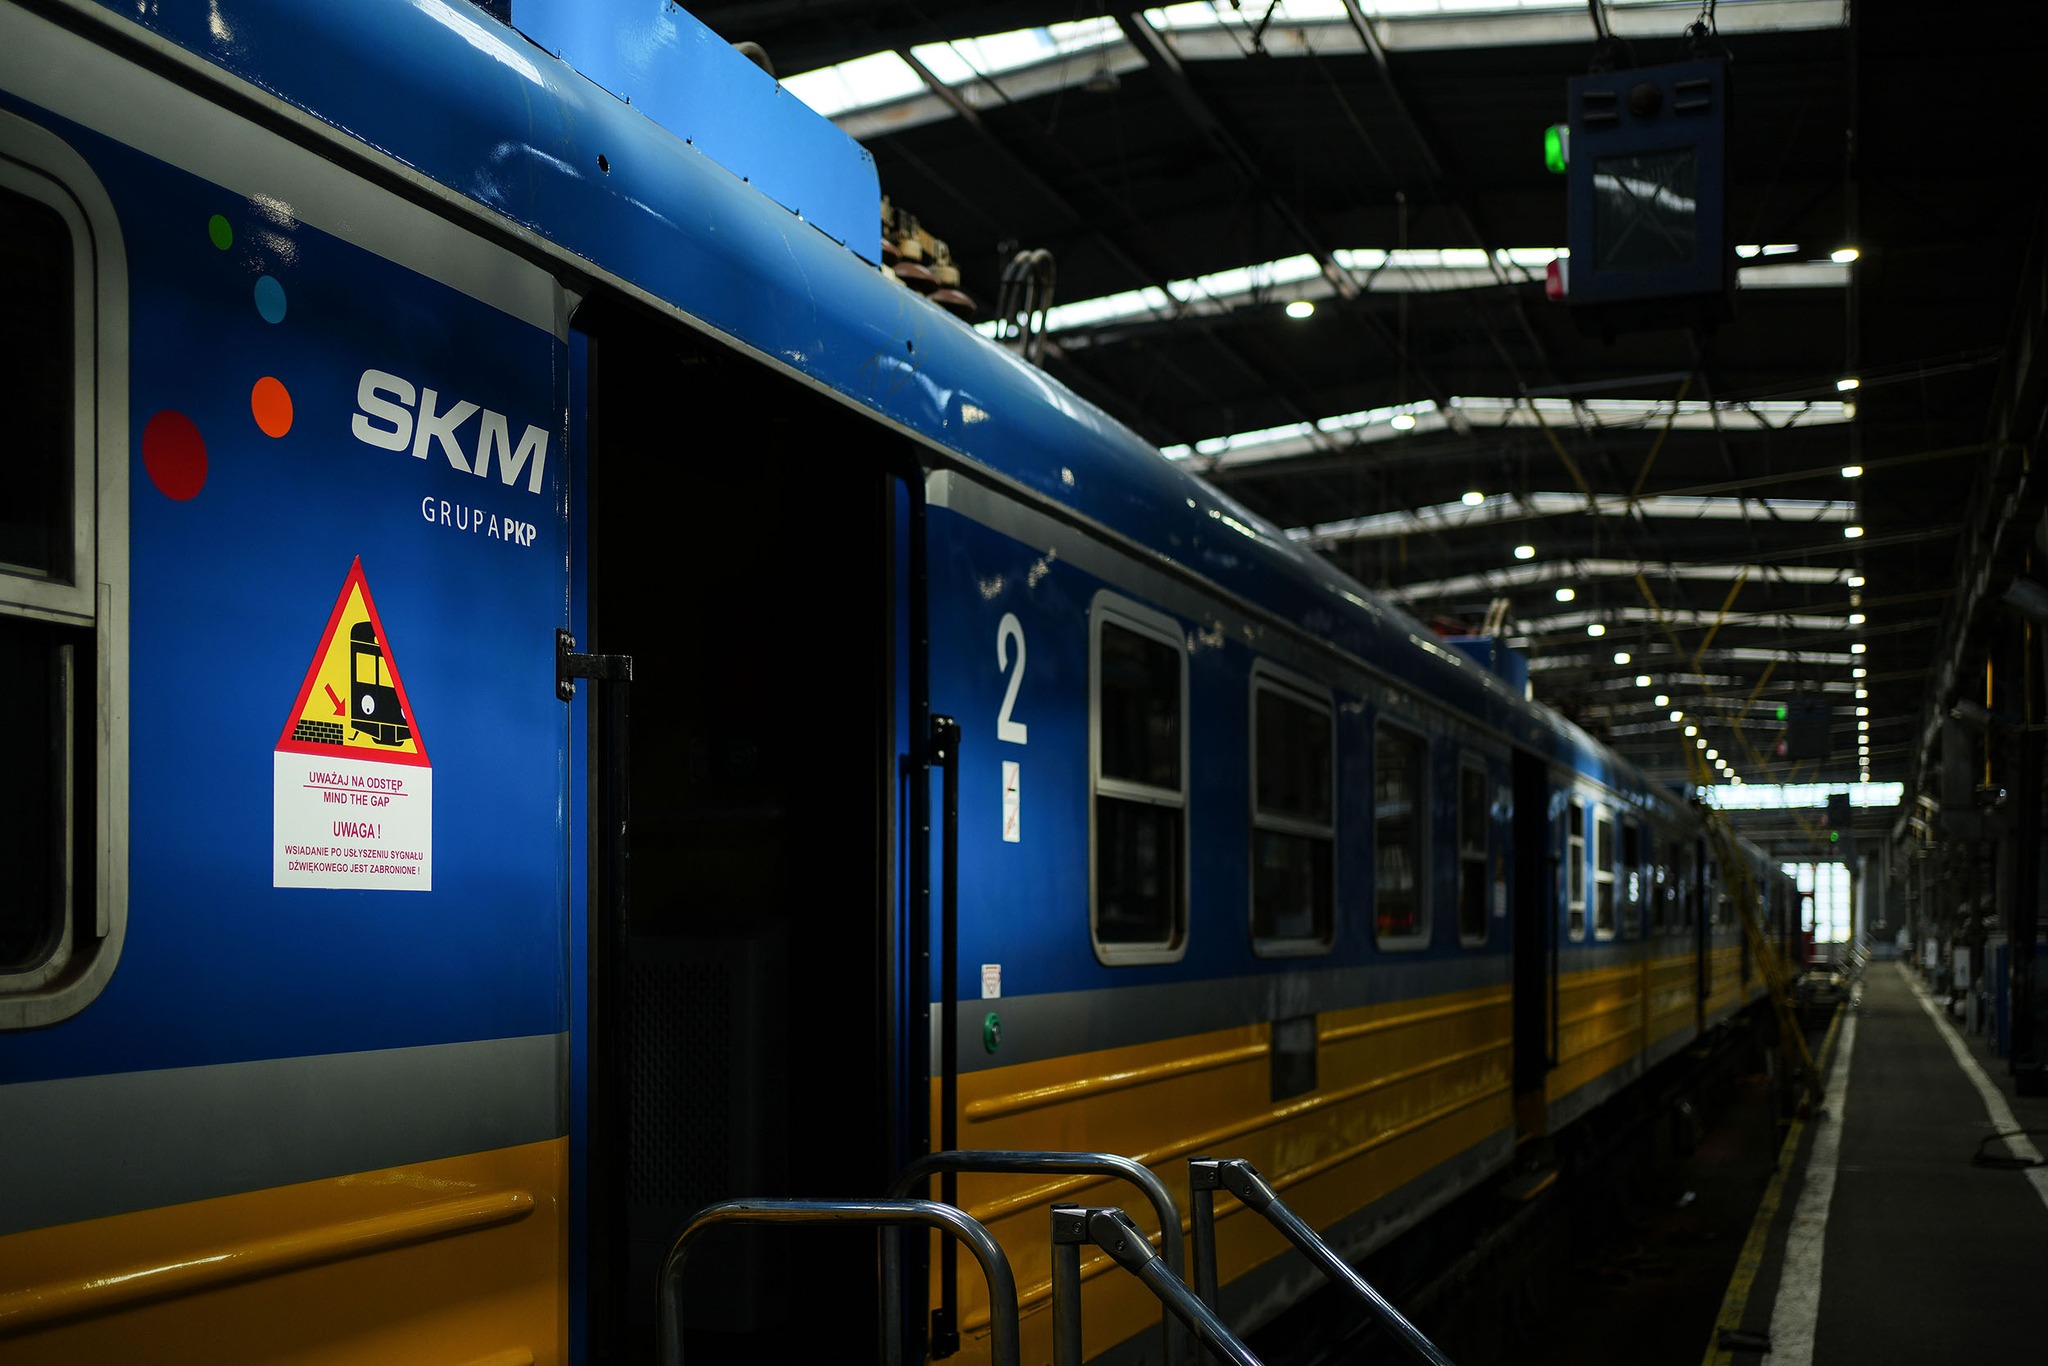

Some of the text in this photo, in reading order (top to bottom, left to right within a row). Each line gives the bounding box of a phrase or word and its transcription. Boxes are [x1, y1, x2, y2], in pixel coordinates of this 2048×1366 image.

[351, 368, 550, 495] SKM
[996, 612, 1028, 745] 2
[309, 771, 403, 792] UWAŻAJ NA ODSTĘP
[324, 792, 390, 807] MIND THE GAP
[333, 821, 375, 838] UWAGA
[285, 845, 424, 860] WSIADANIE PO USŁYSZENIU SYGNAŁU
[350, 864, 368, 873] JEST
[370, 865, 416, 875] ZABRONIONE
